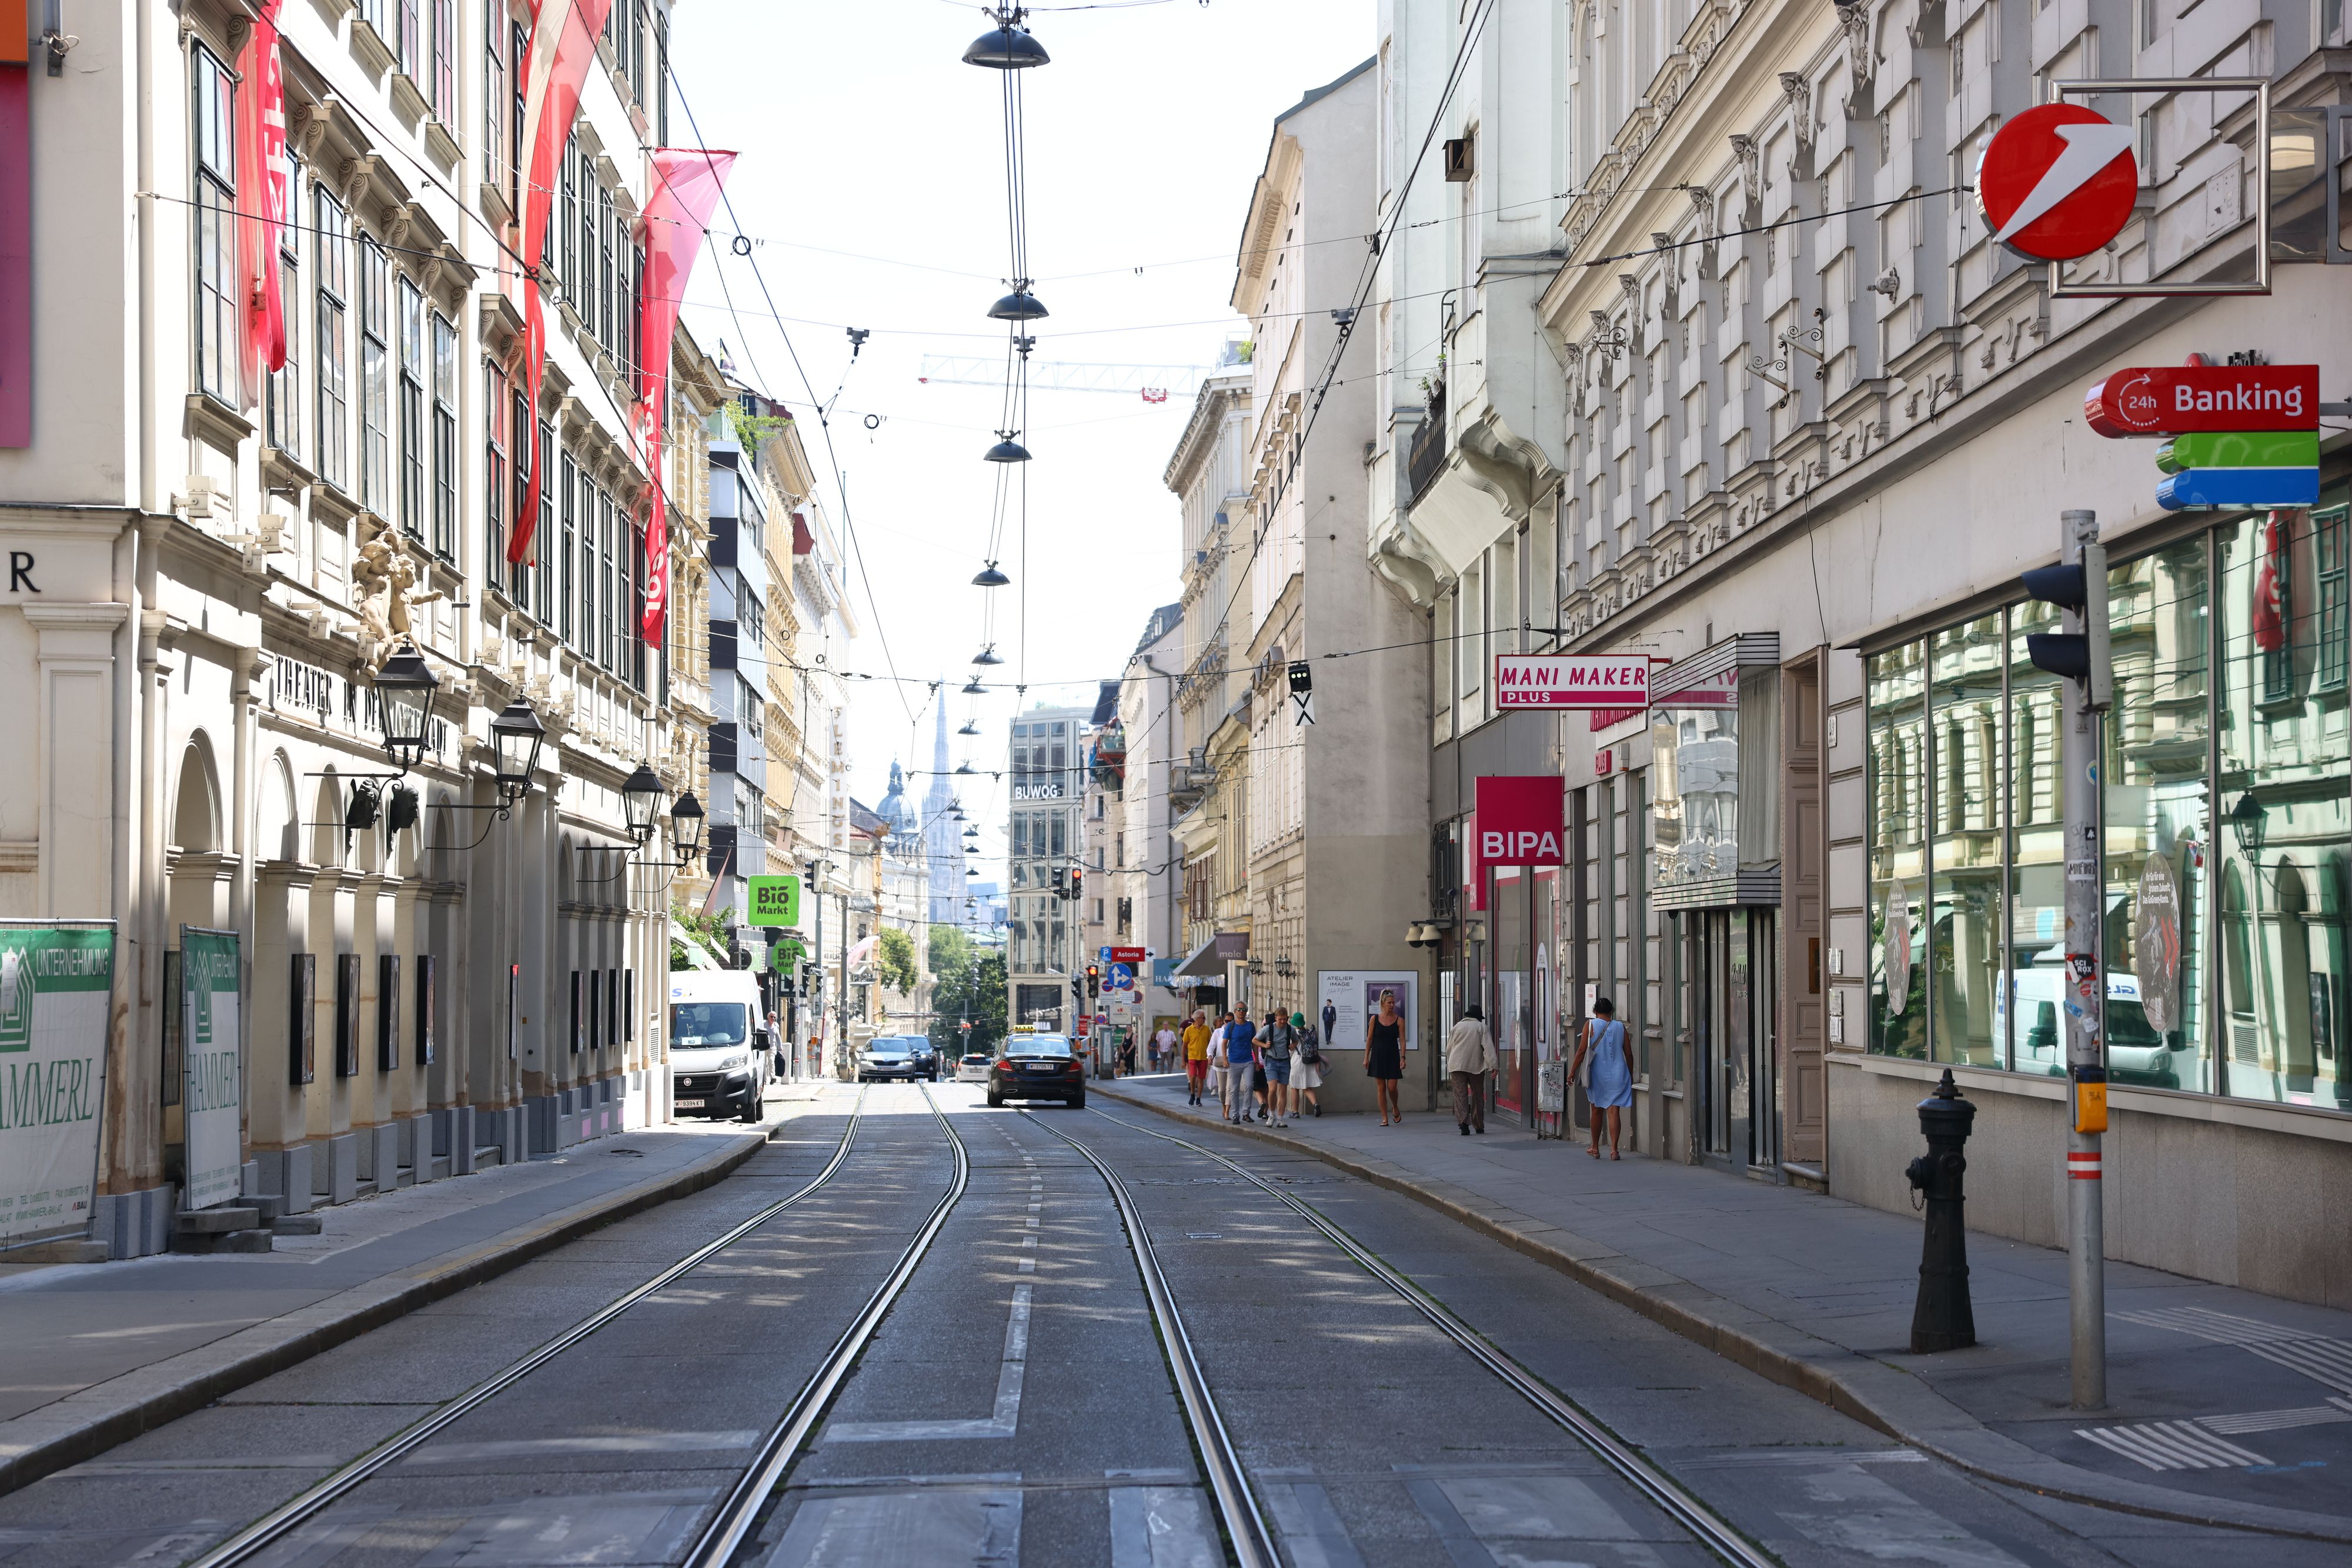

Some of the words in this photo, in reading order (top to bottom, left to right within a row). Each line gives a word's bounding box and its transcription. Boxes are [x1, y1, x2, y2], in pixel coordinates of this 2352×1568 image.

[2129, 396, 2157, 409] 24h
[2175, 383, 2303, 416] Banking
[1501, 667, 1559, 686] MANI
[1569, 667, 1646, 686] MAKER
[276, 654, 332, 717] THEATER
[364, 686, 383, 734] DE
[1507, 692, 1551, 703] PLUS
[1595, 753, 1605, 774] PLUS
[1015, 784, 1058, 800] BUWOG
[1483, 831, 1561, 858] BIPA
[757, 905, 789, 914] Markt
[36, 948, 108, 977] UNTERNEHMUNG
[1219, 950, 1241, 958] mala
[0, 1058, 95, 1129] MMERL
[188, 1051, 238, 1113] HAMMERL
